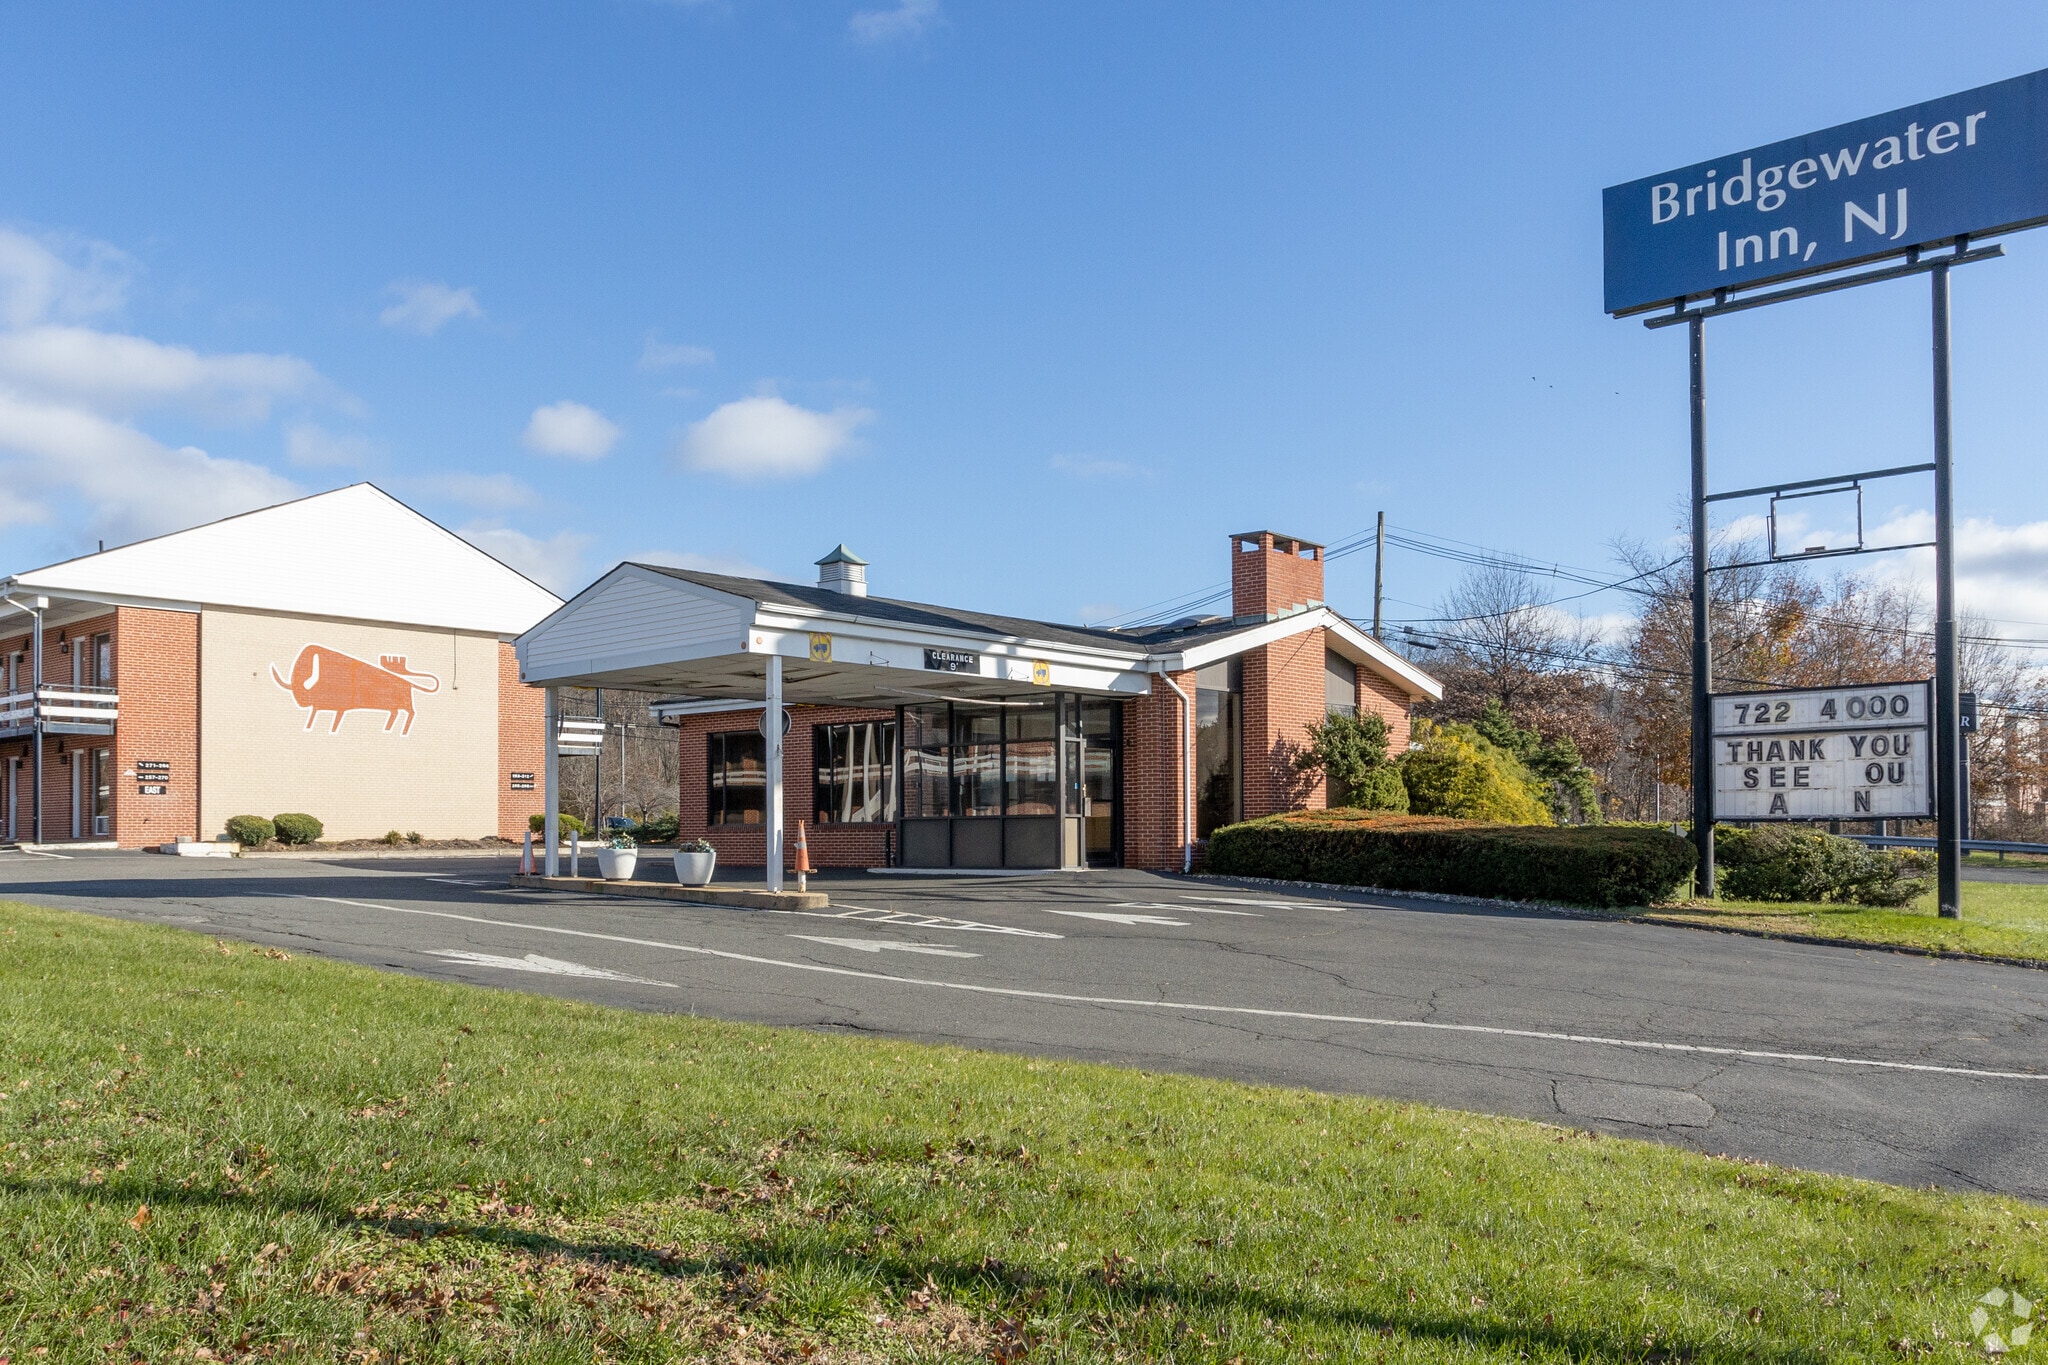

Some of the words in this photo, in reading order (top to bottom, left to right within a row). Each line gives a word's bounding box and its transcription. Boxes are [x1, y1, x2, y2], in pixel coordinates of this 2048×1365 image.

[1651, 111, 1987, 225] Bridgewater
[1718, 225, 1818, 272] Inn,
[1844, 187, 1908, 243] NJ
[932, 652, 974, 664] CLEARANCE
[1734, 702, 1791, 724] 722
[1821, 694, 1910, 720] 4000
[1727, 738, 1826, 763] THANK
[1849, 734, 1911, 758] YOU
[1743, 765, 1810, 788] SEE
[1865, 762, 1905, 784] OU
[144, 786, 160, 794] EAST
[1769, 793, 1789, 815] A
[1854, 790, 1871, 812] N
